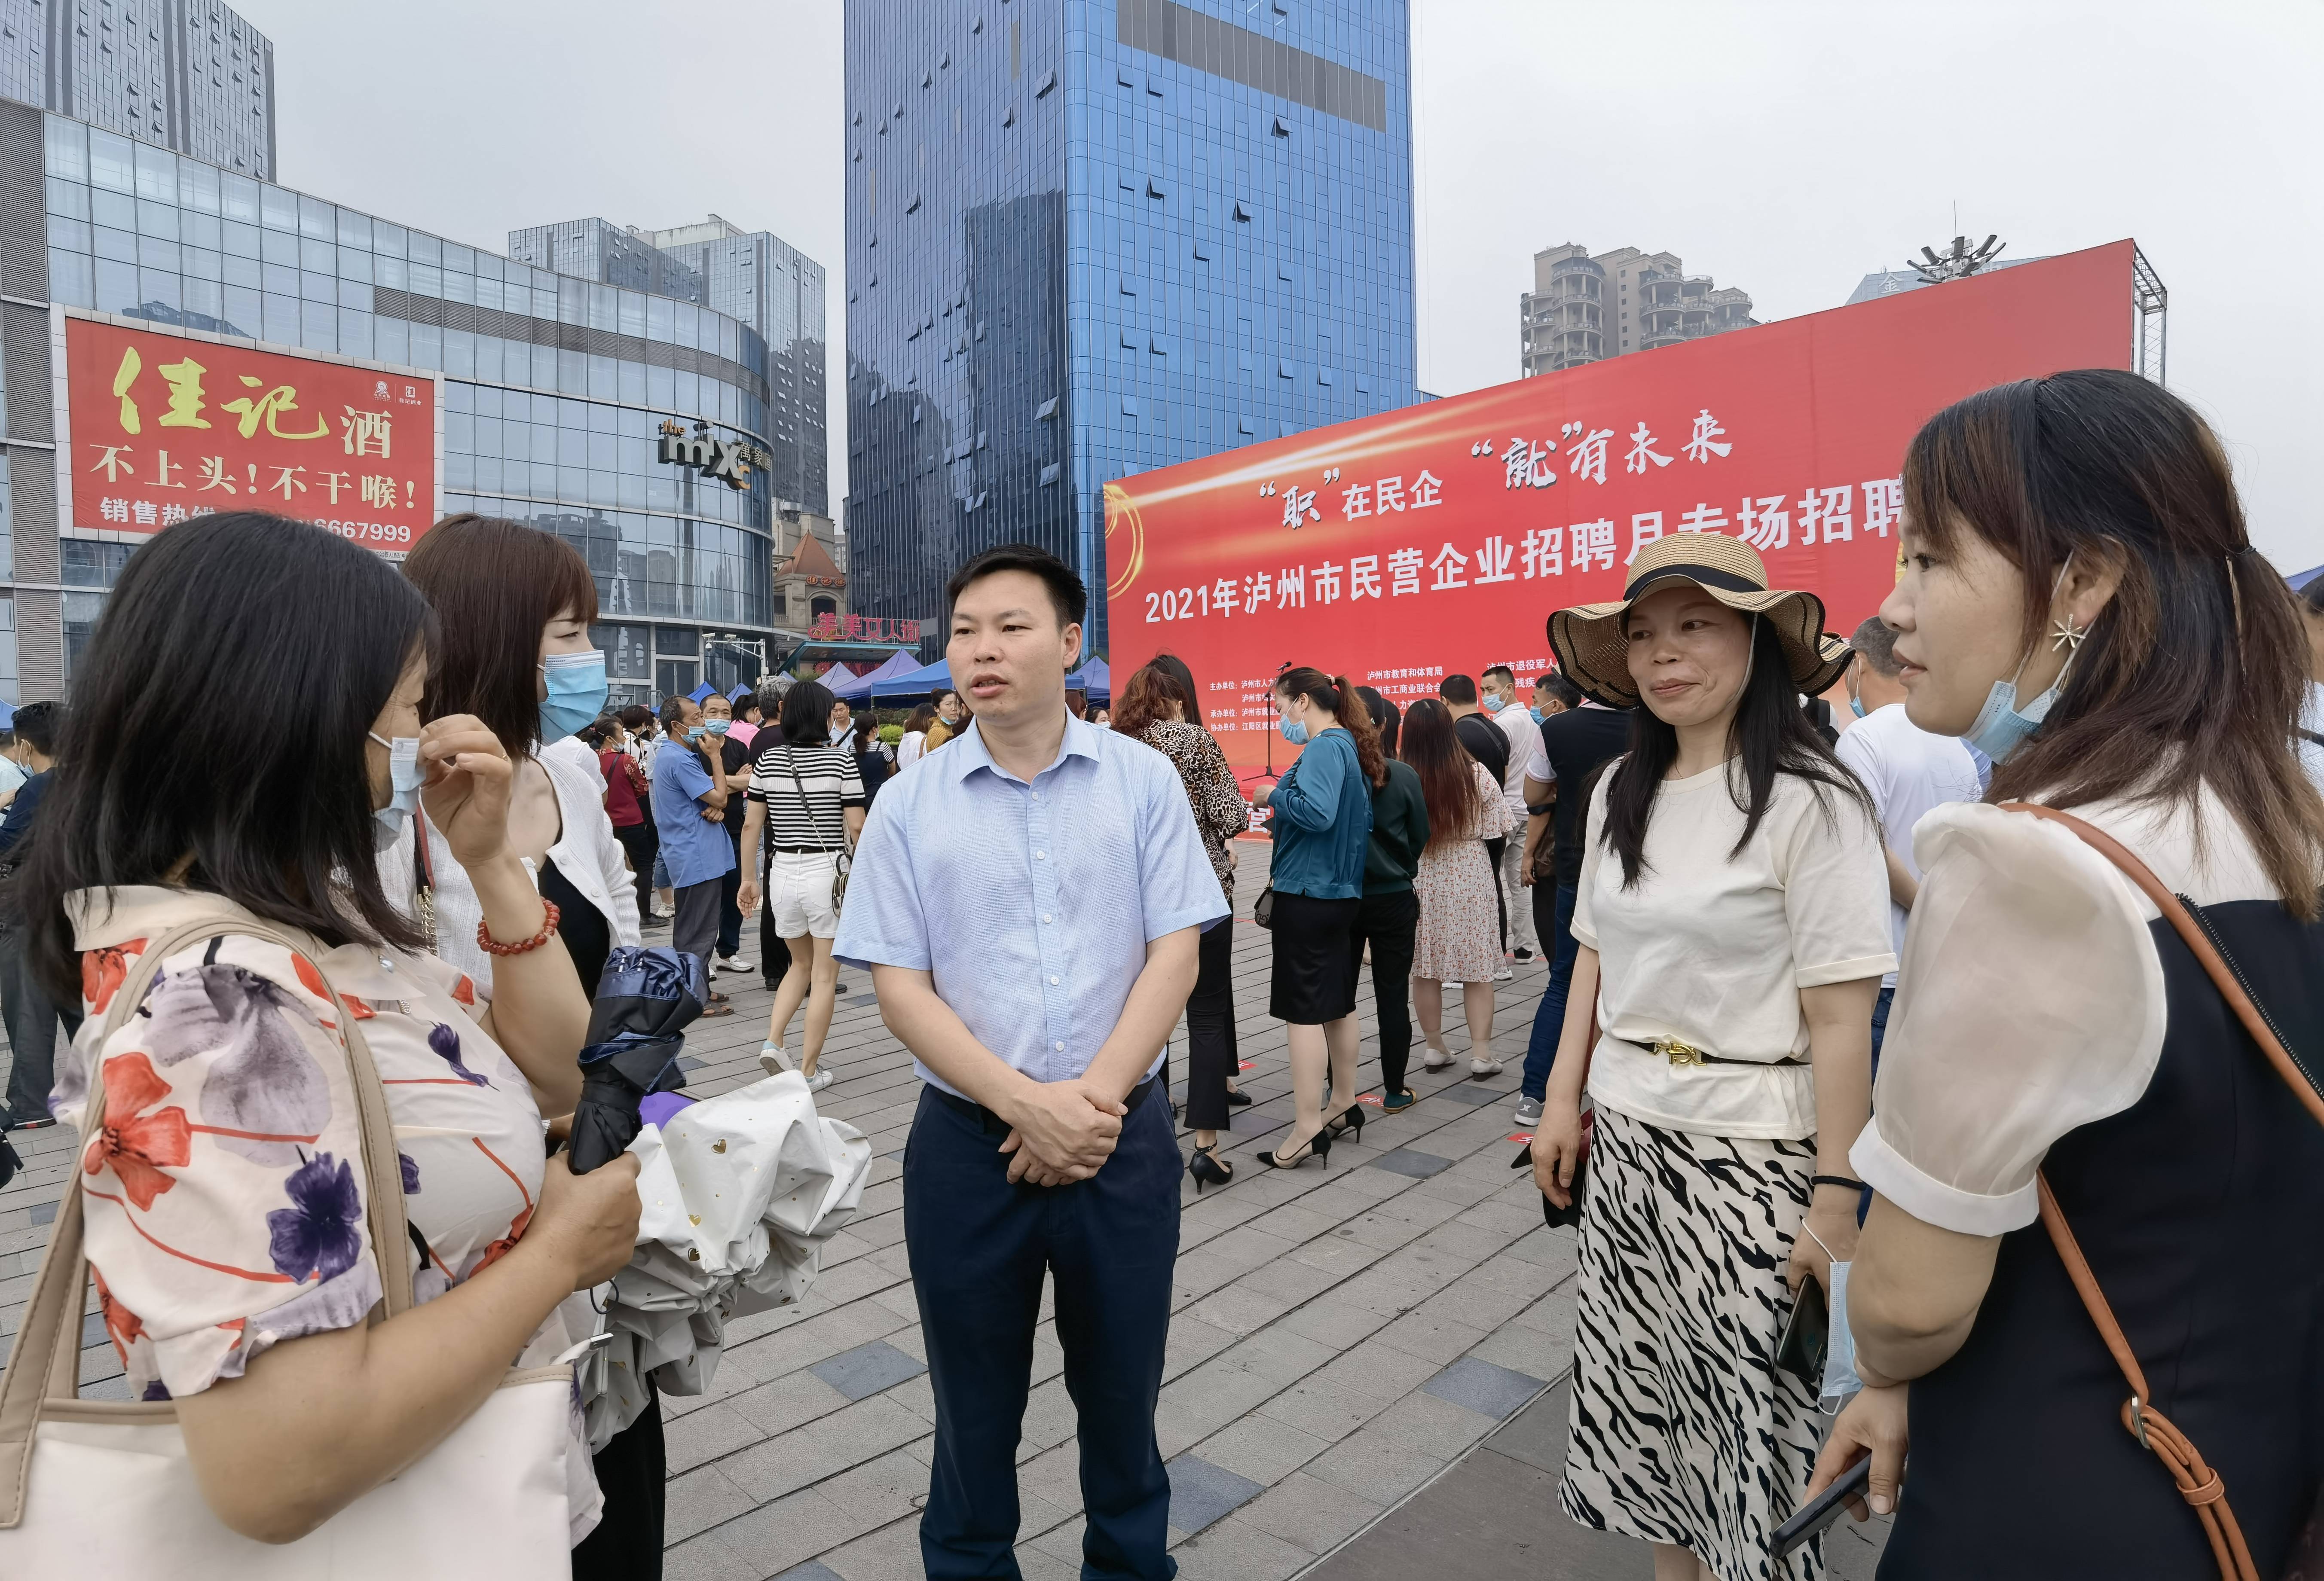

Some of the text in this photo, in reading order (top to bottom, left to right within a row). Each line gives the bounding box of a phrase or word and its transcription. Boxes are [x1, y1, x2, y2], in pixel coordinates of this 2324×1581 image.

[663, 418, 686, 435] the
[1367, 666, 1443, 681] 泸州市教育和体育局
[1371, 682, 1440, 696] 州市工商业联合会
